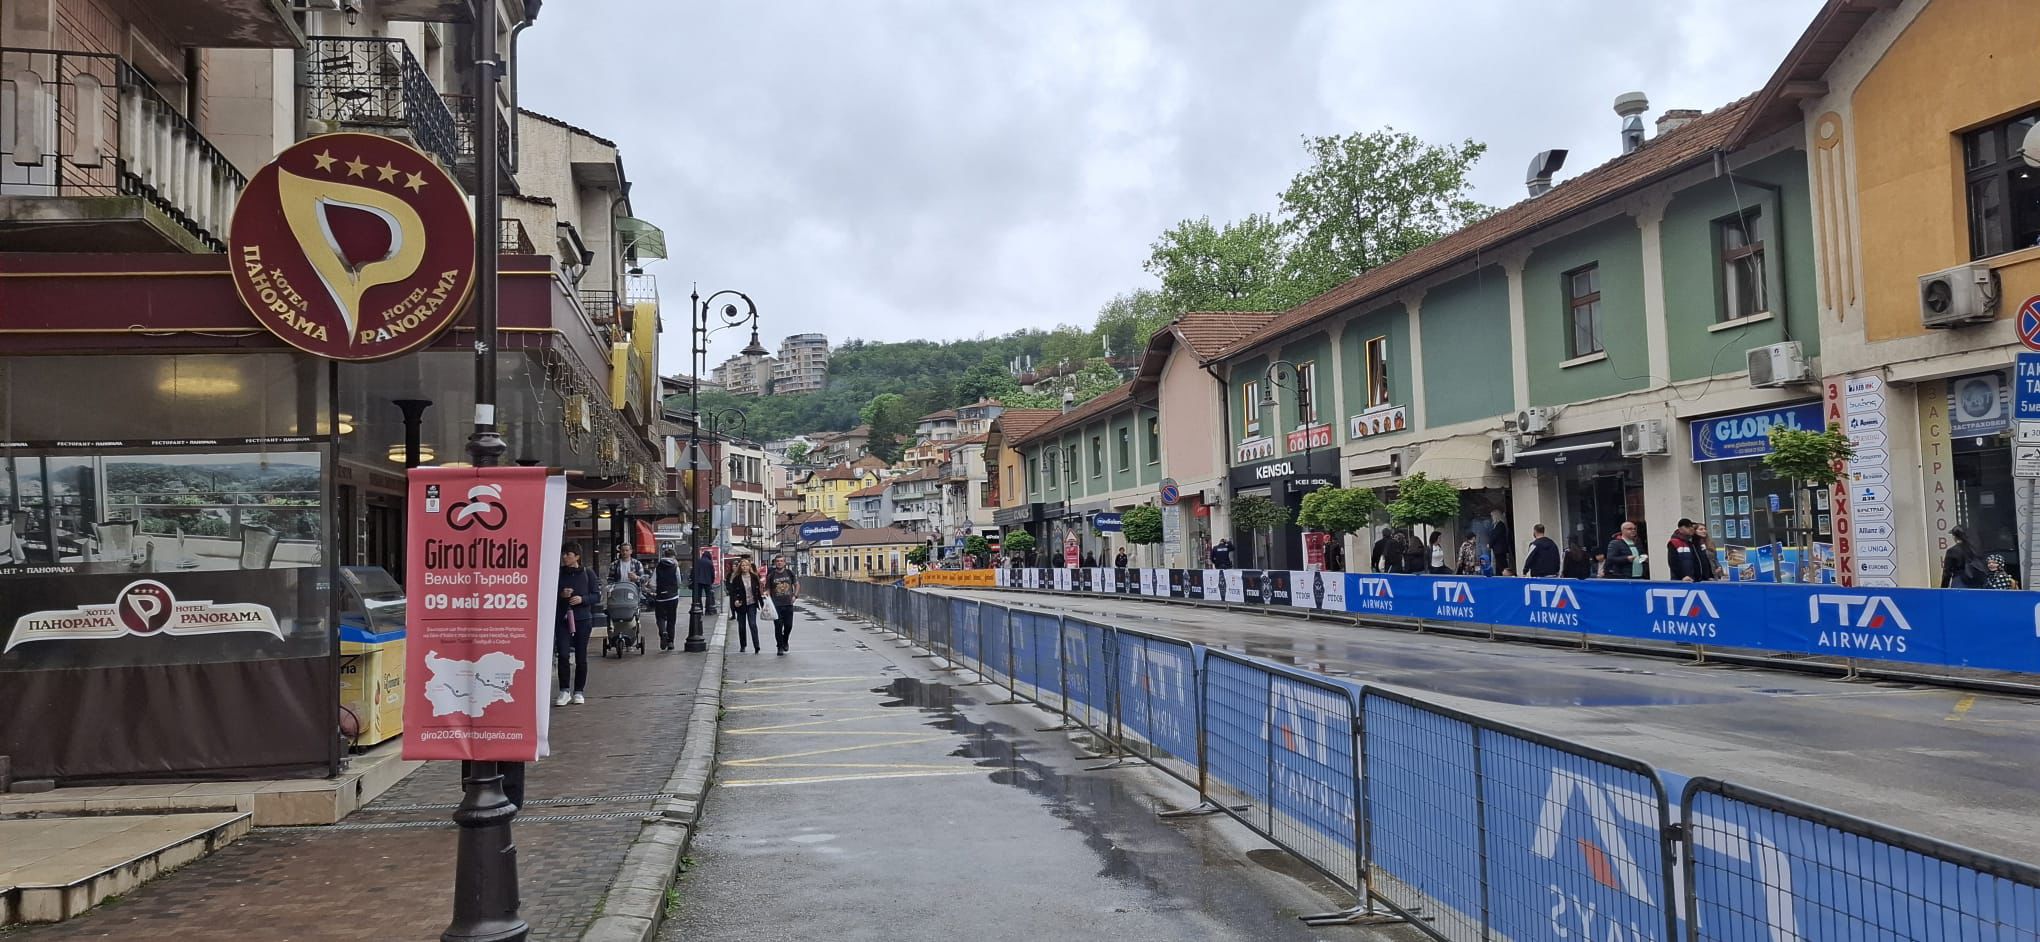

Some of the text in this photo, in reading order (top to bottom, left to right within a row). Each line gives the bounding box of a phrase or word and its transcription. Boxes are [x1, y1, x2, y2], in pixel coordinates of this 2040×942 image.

[243, 245, 328, 342] ПАНОРАМА
[270, 268, 308, 312] ХОТЕЛ
[360, 269, 458, 344] PANORAMA
[382, 288, 428, 320] HOTEL
[2021, 400, 2028, 412] 5
[1716, 412, 1802, 440] GLOBAL
[1256, 461, 1294, 480] KENSOL
[1828, 384, 1852, 588] ЗАРАХОВКИ
[425, 537, 528, 570] Giro d'Italia
[424, 572, 528, 587] Велико Търново
[1360, 577, 1394, 598] ITA
[424, 592, 528, 610] 09 май 2026
[1274, 590, 1288, 598] TUDOR
[1296, 591, 1311, 600] TUDOR
[1327, 594, 1343, 603] TUDOR
[1433, 581, 1475, 604] ITA
[1524, 583, 1581, 610] ITA
[1362, 600, 1393, 611] AIRWAYS
[1437, 605, 1474, 618] AIRWAYS
[1646, 588, 1720, 618] ITA
[1809, 594, 1912, 630] ITA
[29, 618, 115, 630] ПАНОРАМА
[180, 612, 262, 624] PANORAMA
[1529, 611, 1578, 626] AIRWAYS
[1652, 620, 1716, 638] AIRWAYS
[1818, 631, 1906, 653] AIRWAYS
